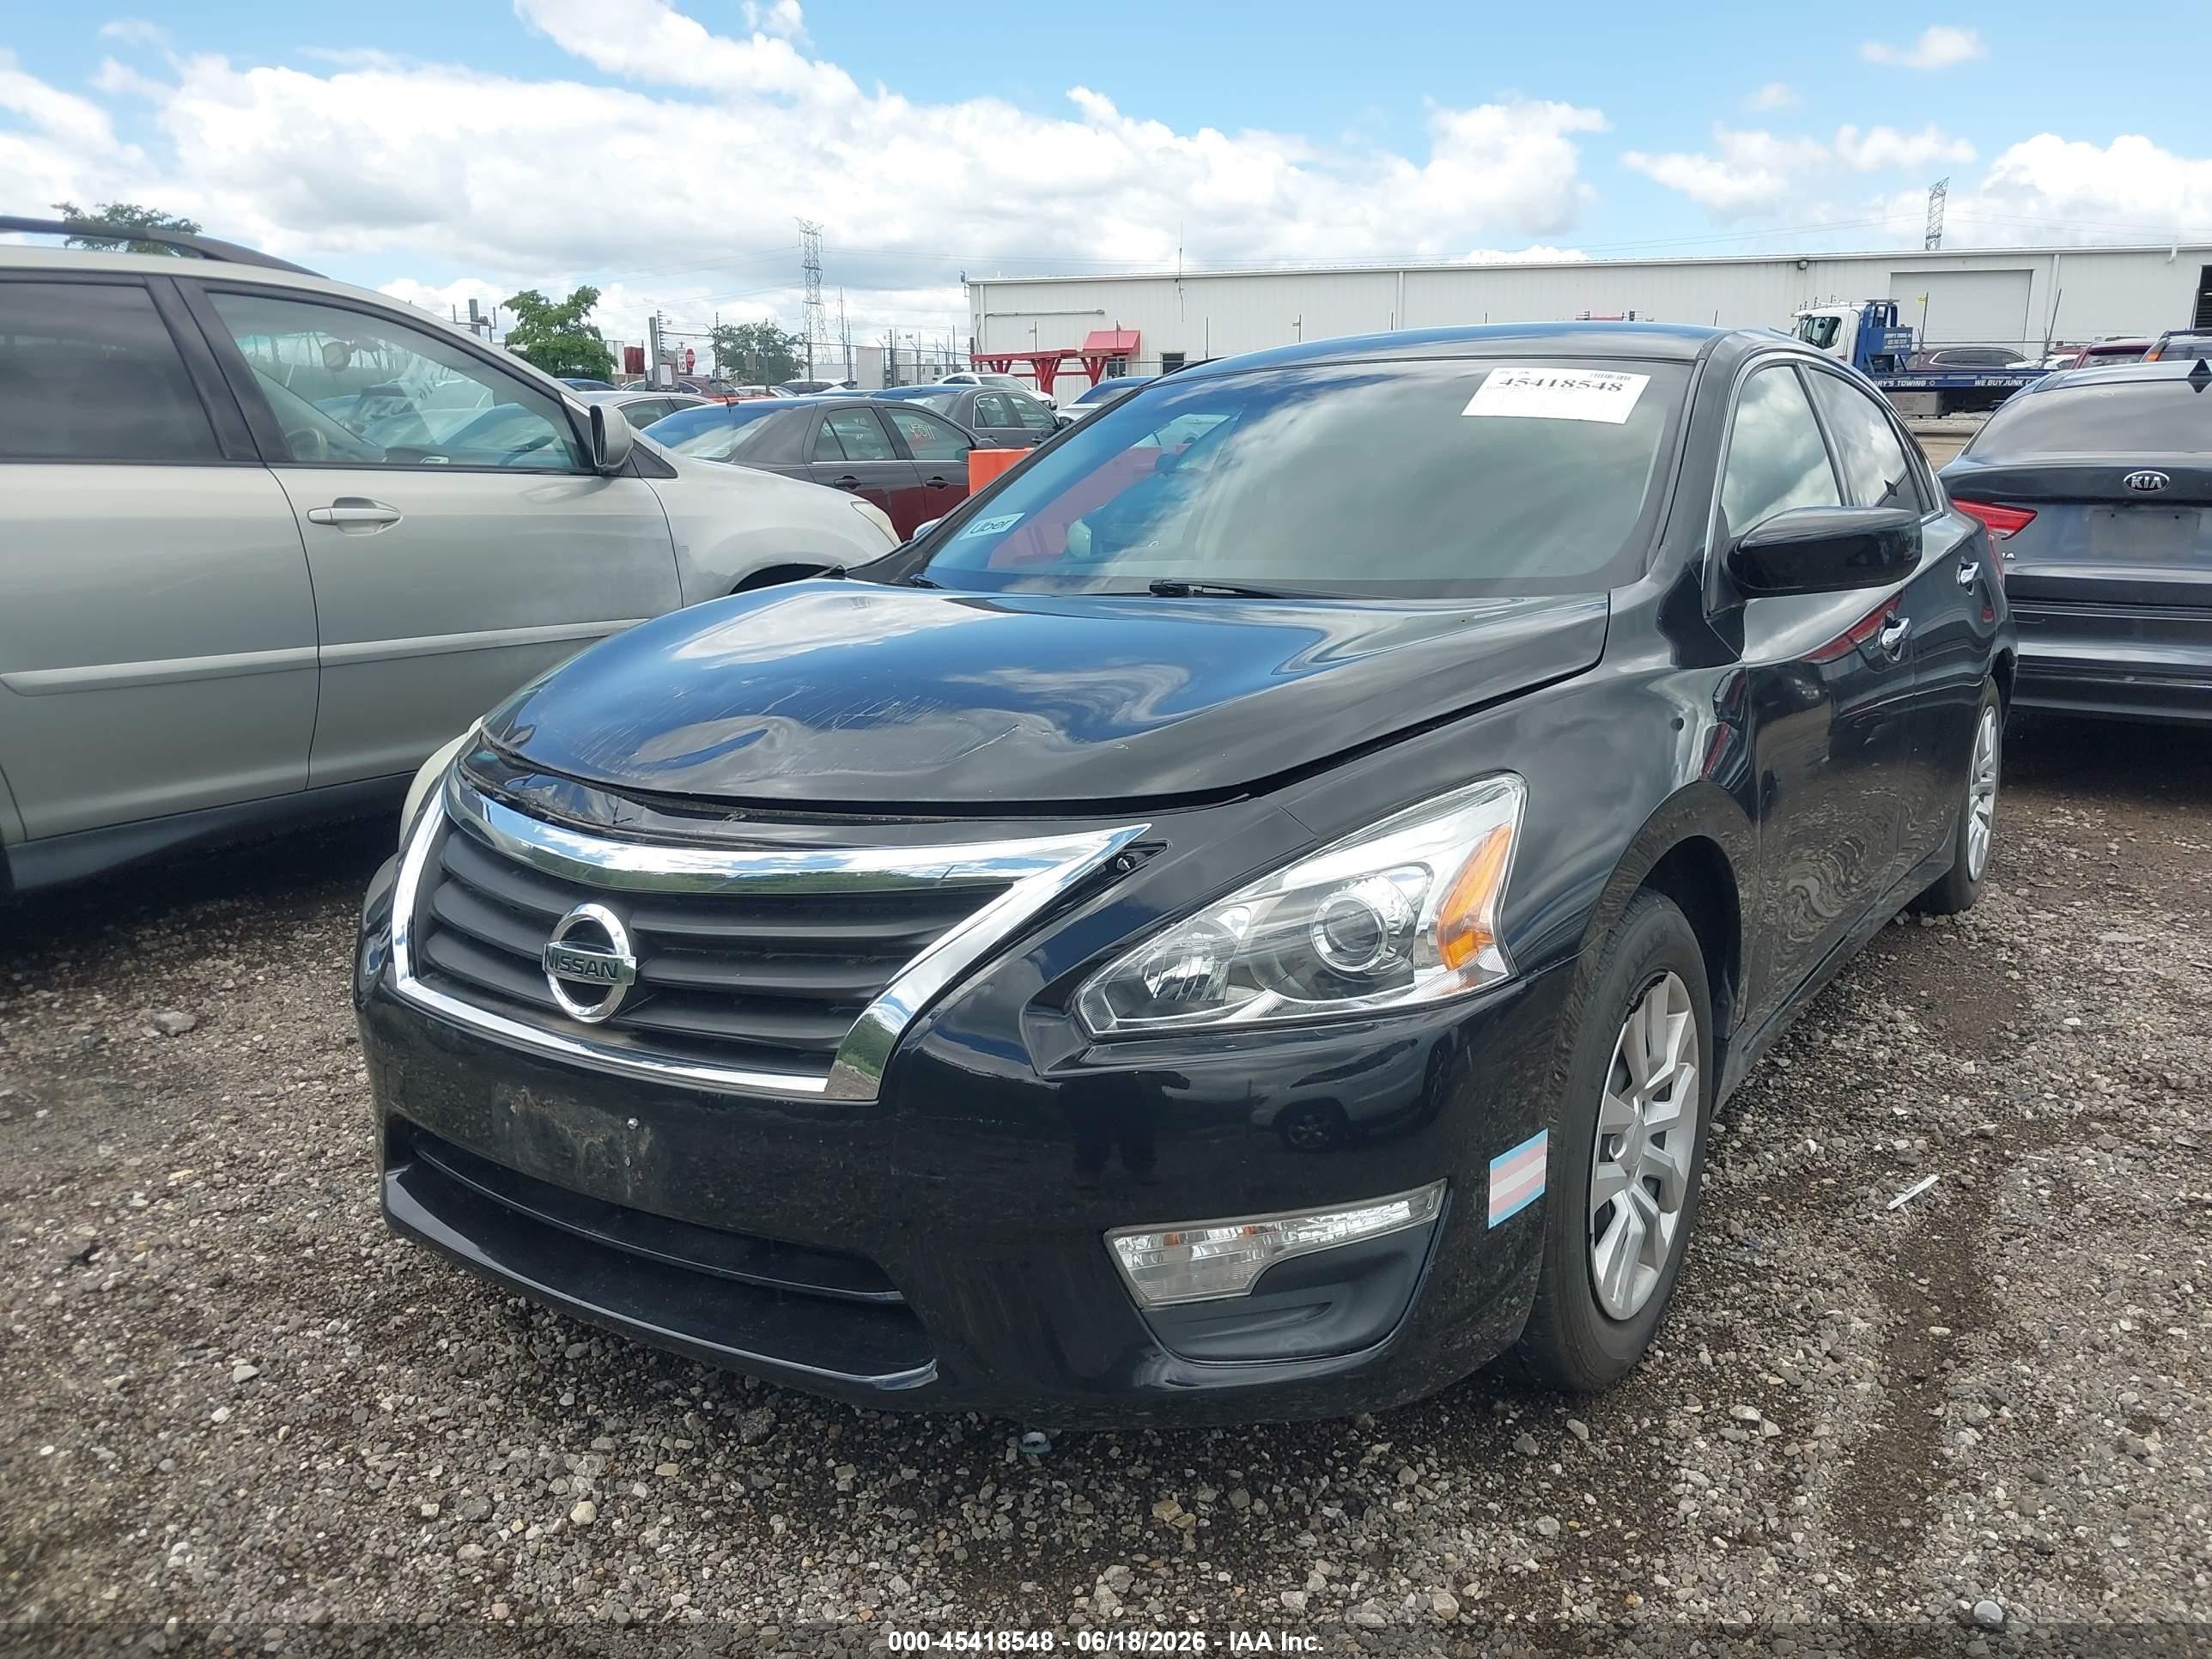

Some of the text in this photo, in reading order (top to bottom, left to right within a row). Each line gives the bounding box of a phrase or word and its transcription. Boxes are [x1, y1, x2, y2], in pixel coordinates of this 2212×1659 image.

[678, 361, 686, 371] 10
[1498, 377, 1624, 392] 45418548
[2130, 476, 2162, 489] KIA
[969, 519, 1013, 534] Uber
[545, 951, 619, 981] NISSAN
